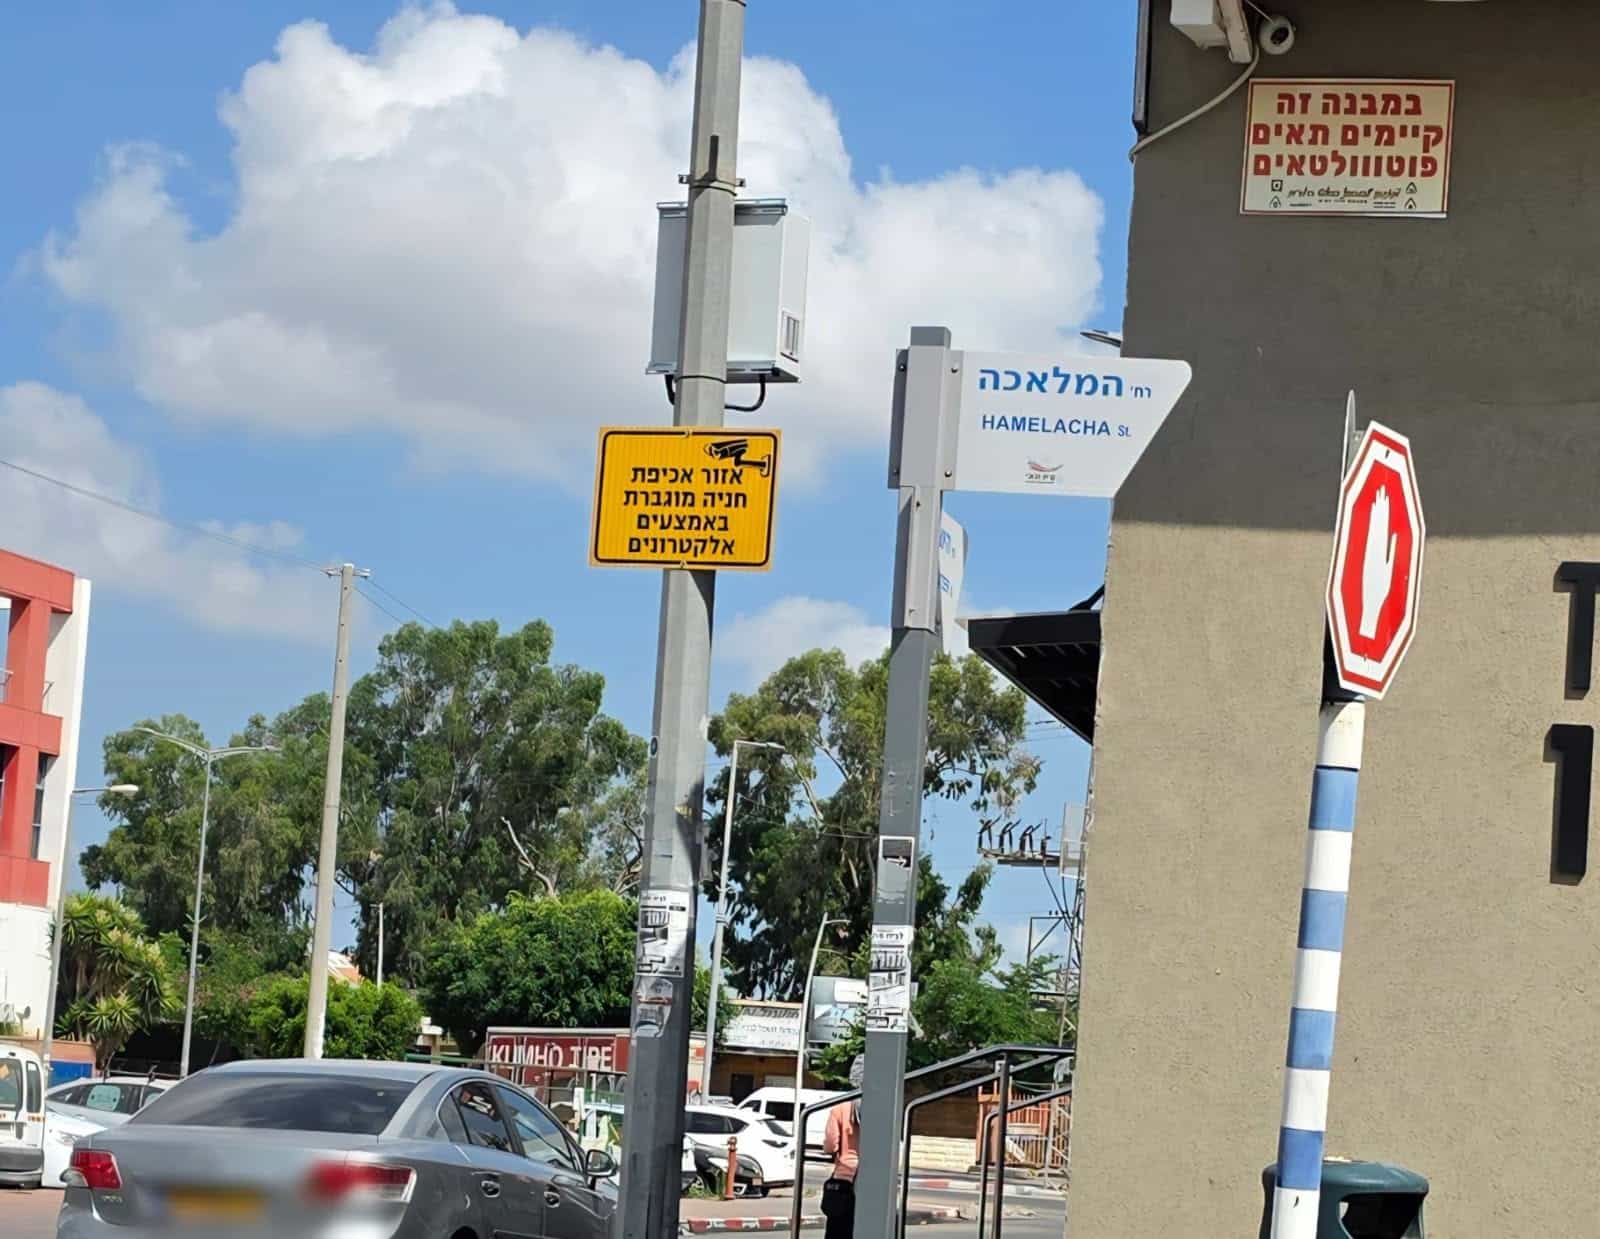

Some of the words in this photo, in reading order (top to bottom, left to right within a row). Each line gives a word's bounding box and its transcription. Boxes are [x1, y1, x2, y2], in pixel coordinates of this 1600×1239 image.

[1277, 92, 1312, 115] זה
[1322, 92, 1422, 116] במבנה
[1252, 123, 1330, 146] תאים
[1340, 124, 1444, 153] קיימים
[978, 366, 1124, 397] המלאכה
[981, 414, 1111, 436] HAMELACHA
[631, 467, 694, 484] אכיפת
[702, 468, 743, 484] אזור
[624, 490, 695, 507] מוגברת
[703, 492, 747, 508] חניה
[637, 513, 729, 531] באמצעים
[629, 536, 735, 557] אלקטרונים
